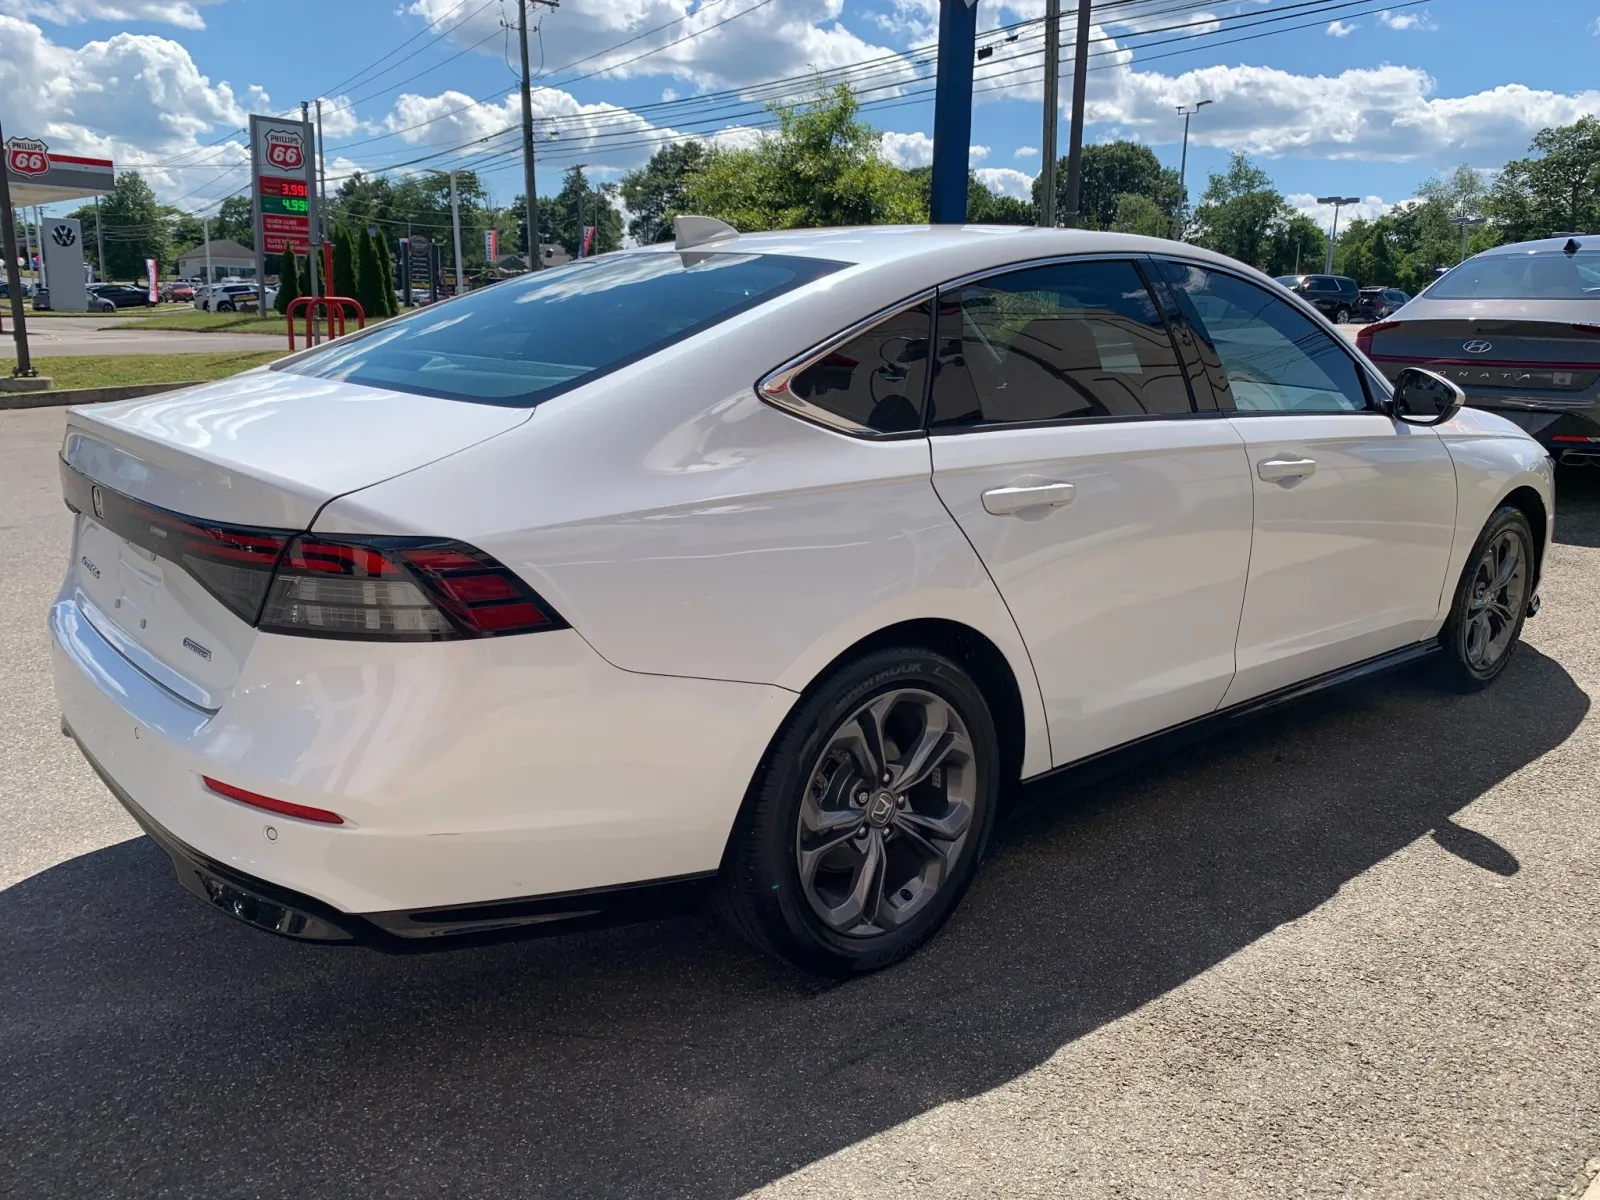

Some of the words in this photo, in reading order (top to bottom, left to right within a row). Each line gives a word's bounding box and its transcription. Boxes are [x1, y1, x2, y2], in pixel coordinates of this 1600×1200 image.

[271, 135, 299, 144] PHILLIPS
[12, 142, 43, 151] PHILLIPS
[273, 146, 297, 163] 66
[15, 153, 42, 169] 66
[1437, 369, 1531, 379] ONATA
